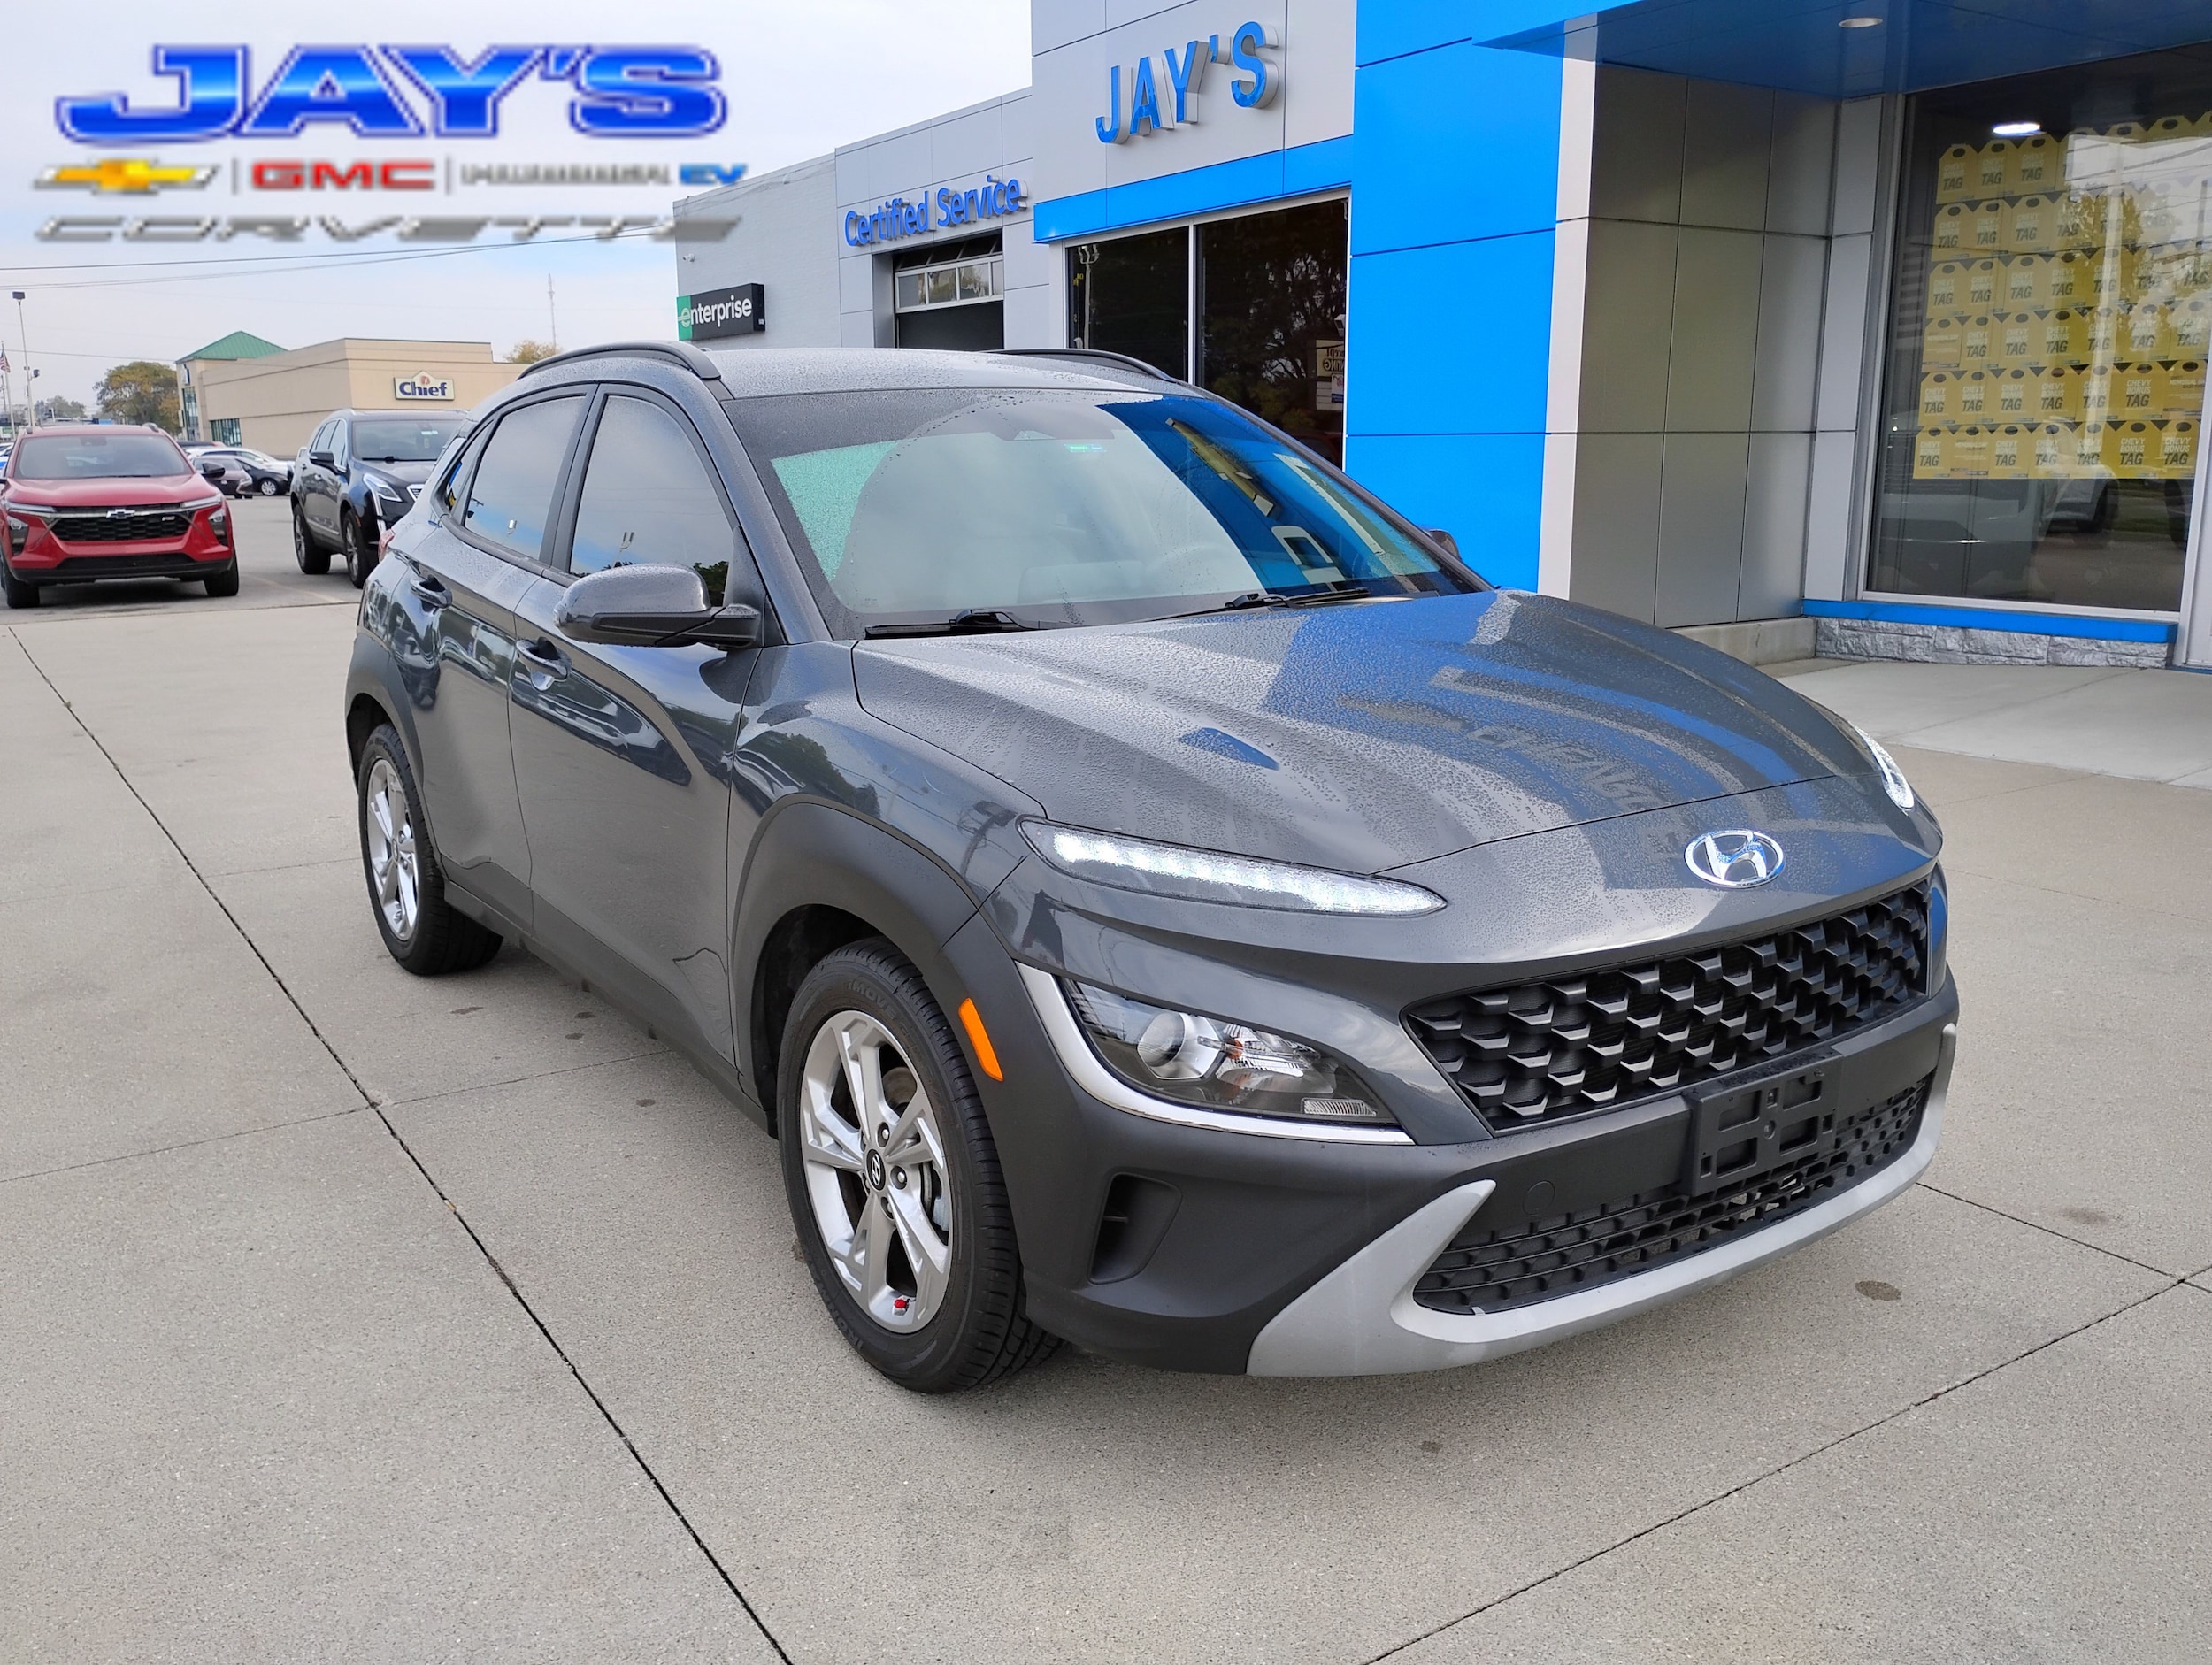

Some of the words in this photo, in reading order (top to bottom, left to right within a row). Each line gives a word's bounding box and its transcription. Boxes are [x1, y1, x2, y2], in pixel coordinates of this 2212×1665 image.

[1095, 21, 1276, 143] JAY'S
[1982, 173, 2002, 185] TAG
[2021, 168, 2042, 181] TAG
[1943, 177, 1962, 190] TAG
[844, 190, 930, 247] Certified
[937, 174, 1023, 227] Service
[1977, 231, 1996, 244] TAG
[2016, 228, 2037, 241] TAG
[1939, 235, 1958, 248] TAG
[2010, 286, 2032, 299] TAG
[2051, 282, 2073, 295] TAG
[1933, 293, 1954, 305] TAG
[1970, 289, 1991, 303] TAG
[679, 295, 752, 328] enterprise
[2047, 341, 2068, 353] TAG
[2131, 335, 2155, 348] TAG
[1966, 345, 1986, 357] TAG
[2006, 342, 2027, 355] TAG
[399, 381, 448, 396] Chief
[1962, 400, 1983, 411] TAG
[2001, 398, 2022, 410] TAG
[2041, 396, 2062, 409] TAG
[2083, 396, 2106, 408] TAG
[2126, 395, 2149, 407] TAG
[1924, 402, 1944, 413] TAG
[1920, 455, 1939, 467] TAG
[1996, 454, 2016, 466] TAG
[2036, 454, 2057, 465] TAG
[2077, 453, 2100, 465] TAG
[2120, 453, 2143, 465] TAG
[2164, 453, 2188, 465] TAG
